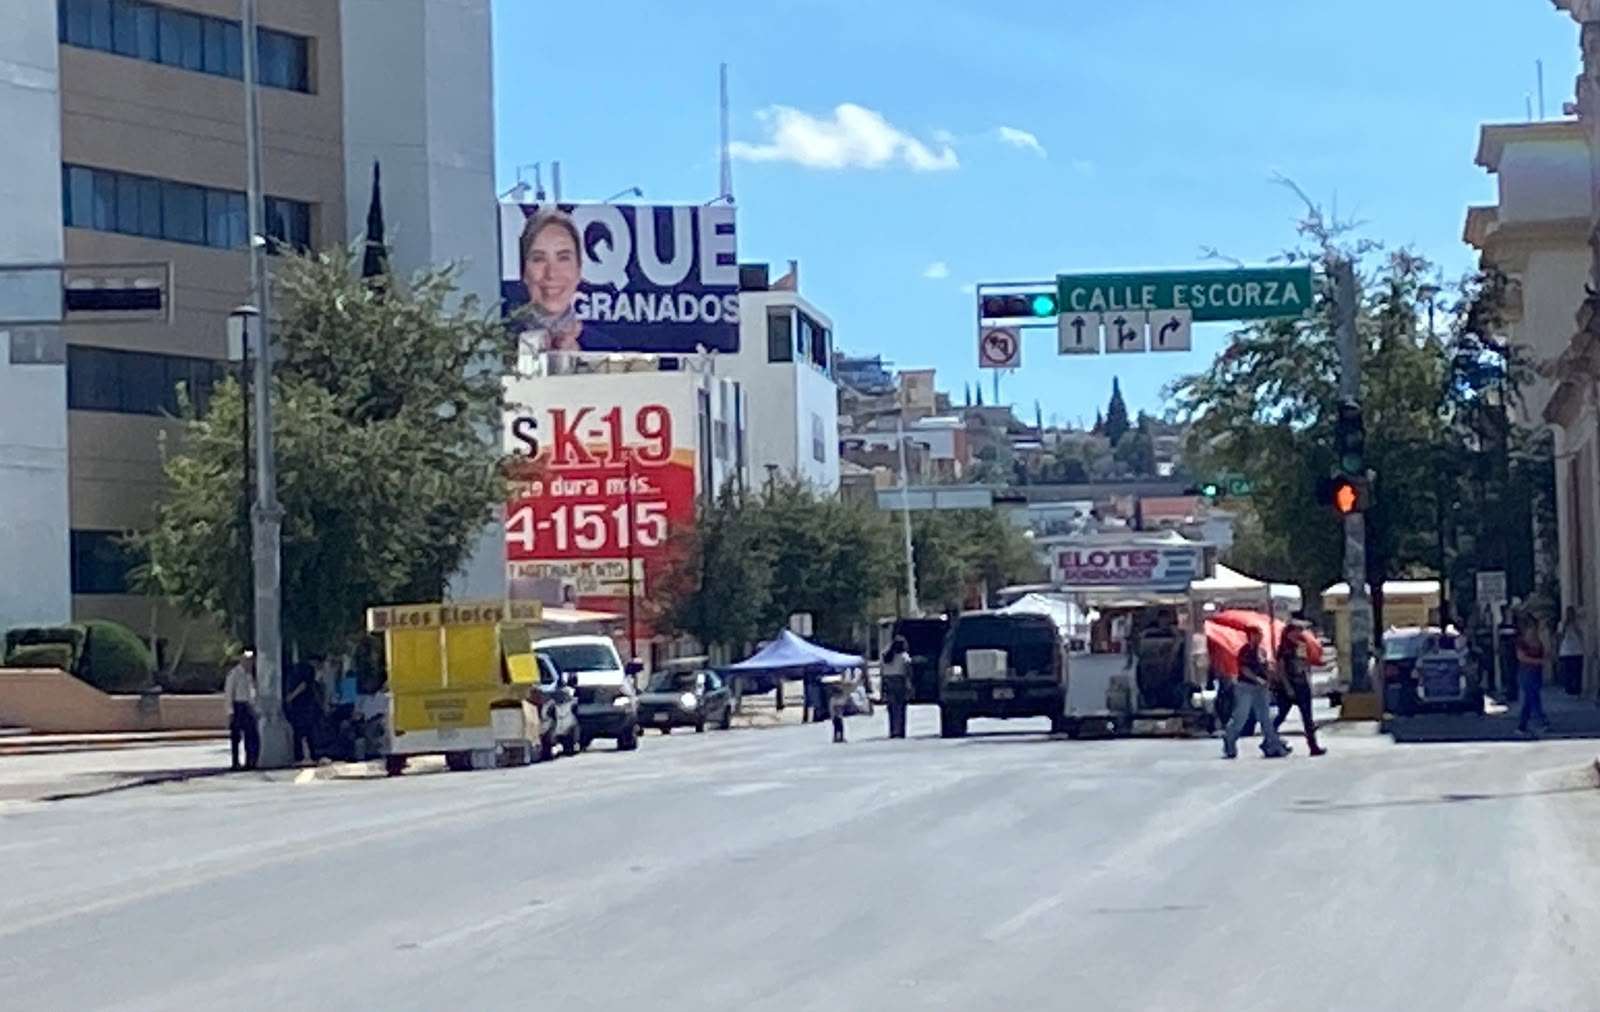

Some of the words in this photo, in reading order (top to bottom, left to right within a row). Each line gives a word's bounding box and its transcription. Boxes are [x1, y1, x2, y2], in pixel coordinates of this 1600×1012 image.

[572, 291, 739, 322] GRANADOS
[1070, 284, 1157, 311] CALLE
[1173, 281, 1301, 307] ESCORZA
[547, 403, 672, 465] K-19
[550, 473, 600, 496] dura
[1058, 550, 1158, 569] ELOTES
